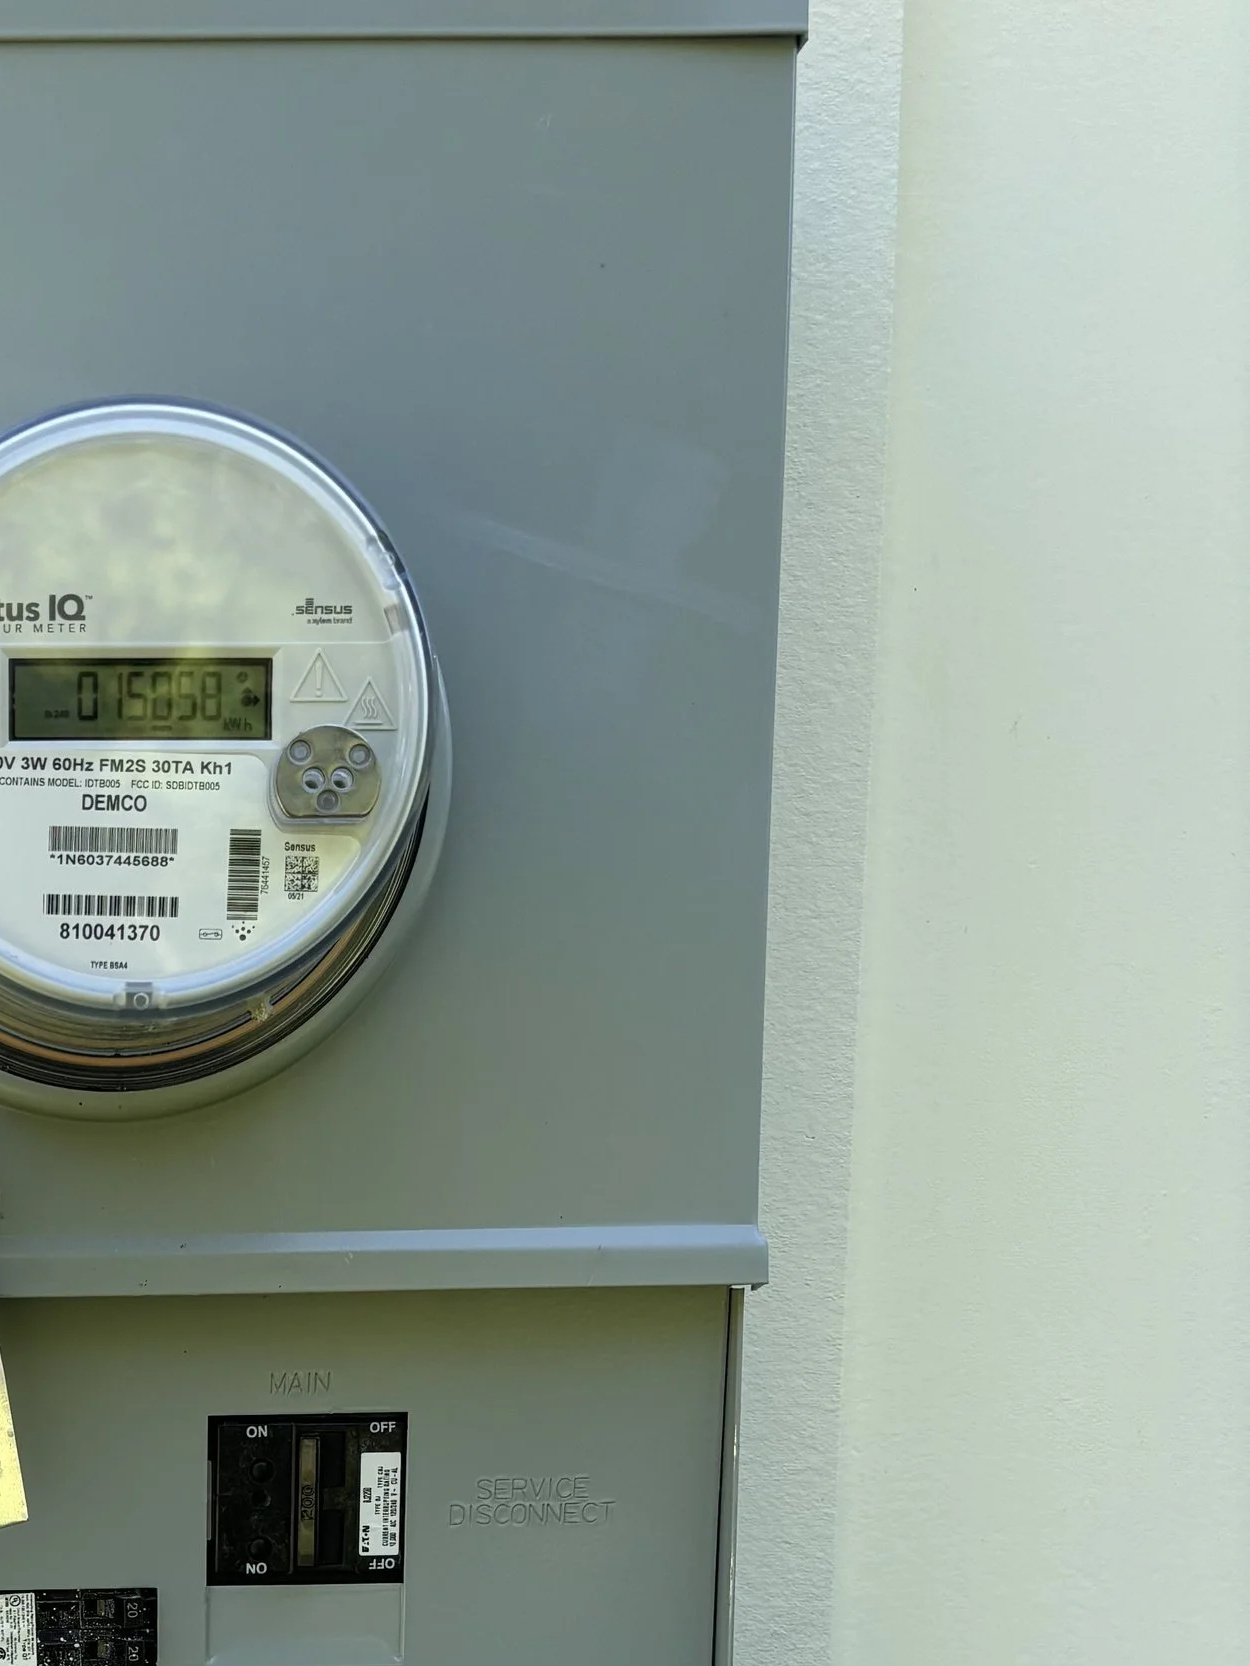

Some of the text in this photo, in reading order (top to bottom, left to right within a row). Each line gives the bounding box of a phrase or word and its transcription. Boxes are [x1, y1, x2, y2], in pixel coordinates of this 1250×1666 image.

[33, 623, 87, 633] METER
[20, 756, 48, 771] 3W
[52, 757, 94, 772] 60Hz
[99, 758, 146, 773] FM2S
[151, 759, 195, 774] 30TA
[200, 761, 232, 775] Kh1
[47, 777, 82, 788] MODEL:
[84, 778, 121, 788] IDTB005
[131, 779, 149, 789] FCC
[151, 780, 163, 790] ID:
[165, 780, 220, 791] SDBIDTB005
[81, 793, 148, 812] DEMCO
[284, 841, 316, 852] Sensus
[59, 922, 161, 941] 810041370
[90, 960, 108, 969] TYPE
[269, 1370, 332, 1395] MAIN
[245, 1425, 269, 1438] ON
[369, 1421, 397, 1433] OFF
[475, 1476, 591, 1501] SERVICE
[448, 1501, 617, 1527] DISCONNECT
[368, 1557, 396, 1570] OFF
[126, 1602, 139, 1619] 20
[128, 1646, 140, 1662] 20
